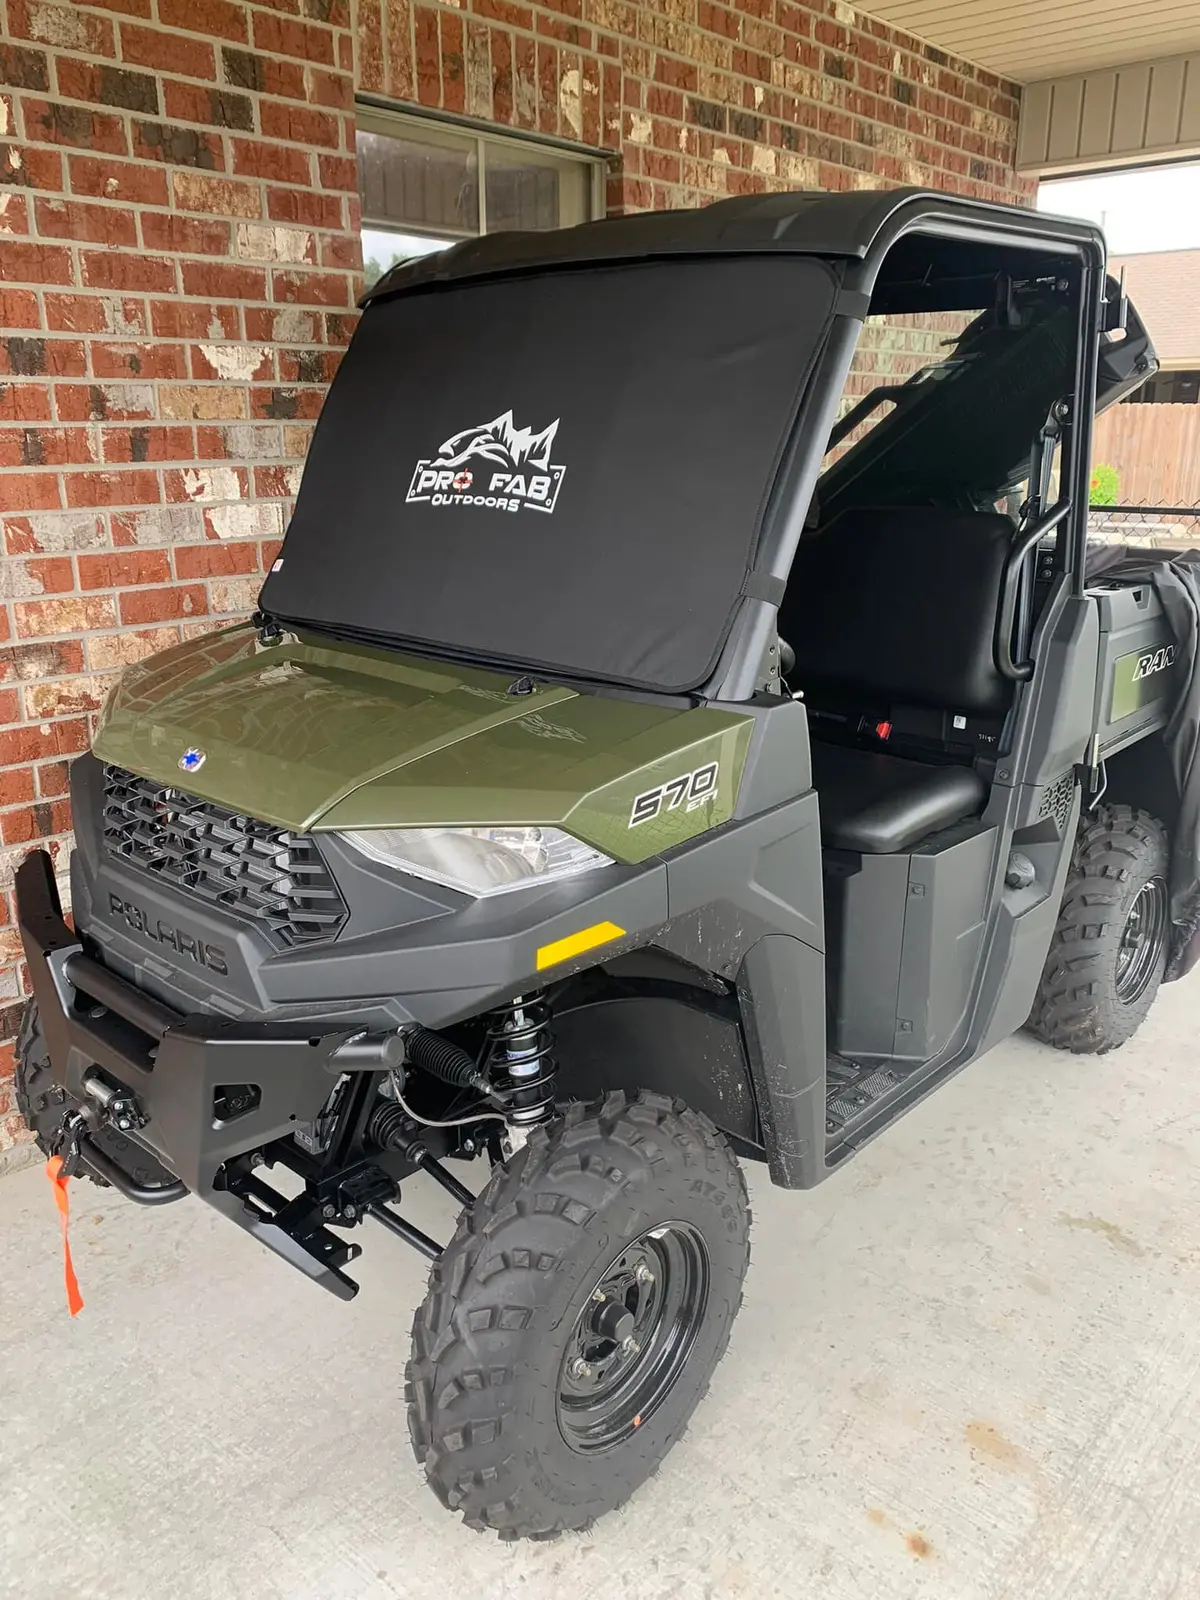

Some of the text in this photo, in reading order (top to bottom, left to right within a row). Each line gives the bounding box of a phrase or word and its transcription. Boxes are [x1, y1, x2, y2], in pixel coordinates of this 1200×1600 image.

[417, 469, 551, 501] PRO FAB
[431, 494, 521, 512] OUTDOORS
[628, 761, 719, 829] 570
[686, 789, 718, 813] EFI
[109, 892, 228, 976] POLARIS
